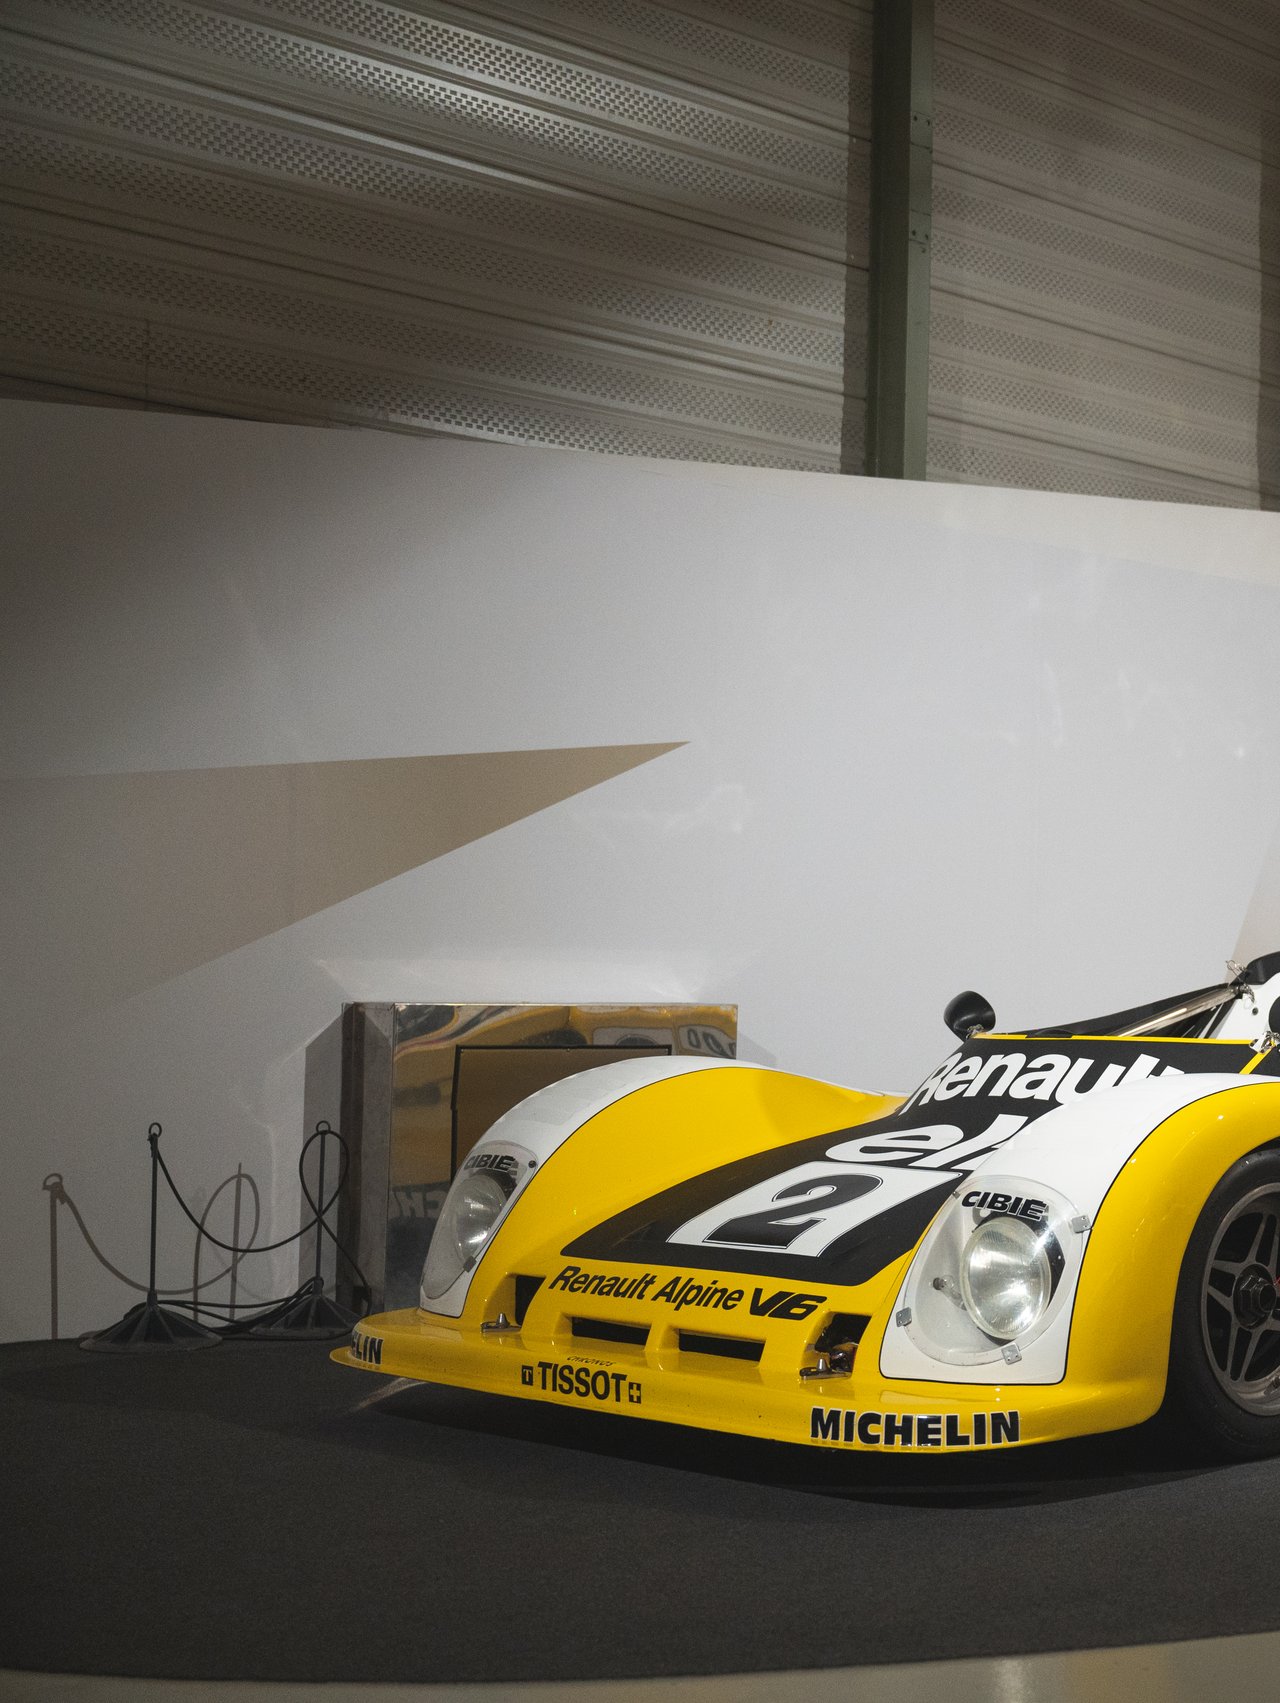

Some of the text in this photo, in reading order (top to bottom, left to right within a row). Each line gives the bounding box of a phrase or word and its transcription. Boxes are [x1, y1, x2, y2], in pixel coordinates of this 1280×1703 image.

[701, 1172, 884, 1250] 2
[549, 1265, 828, 1321] Renault Alpine V6
[537, 1361, 628, 1402] TISSOT
[810, 1405, 1021, 1447] MICHELIN
